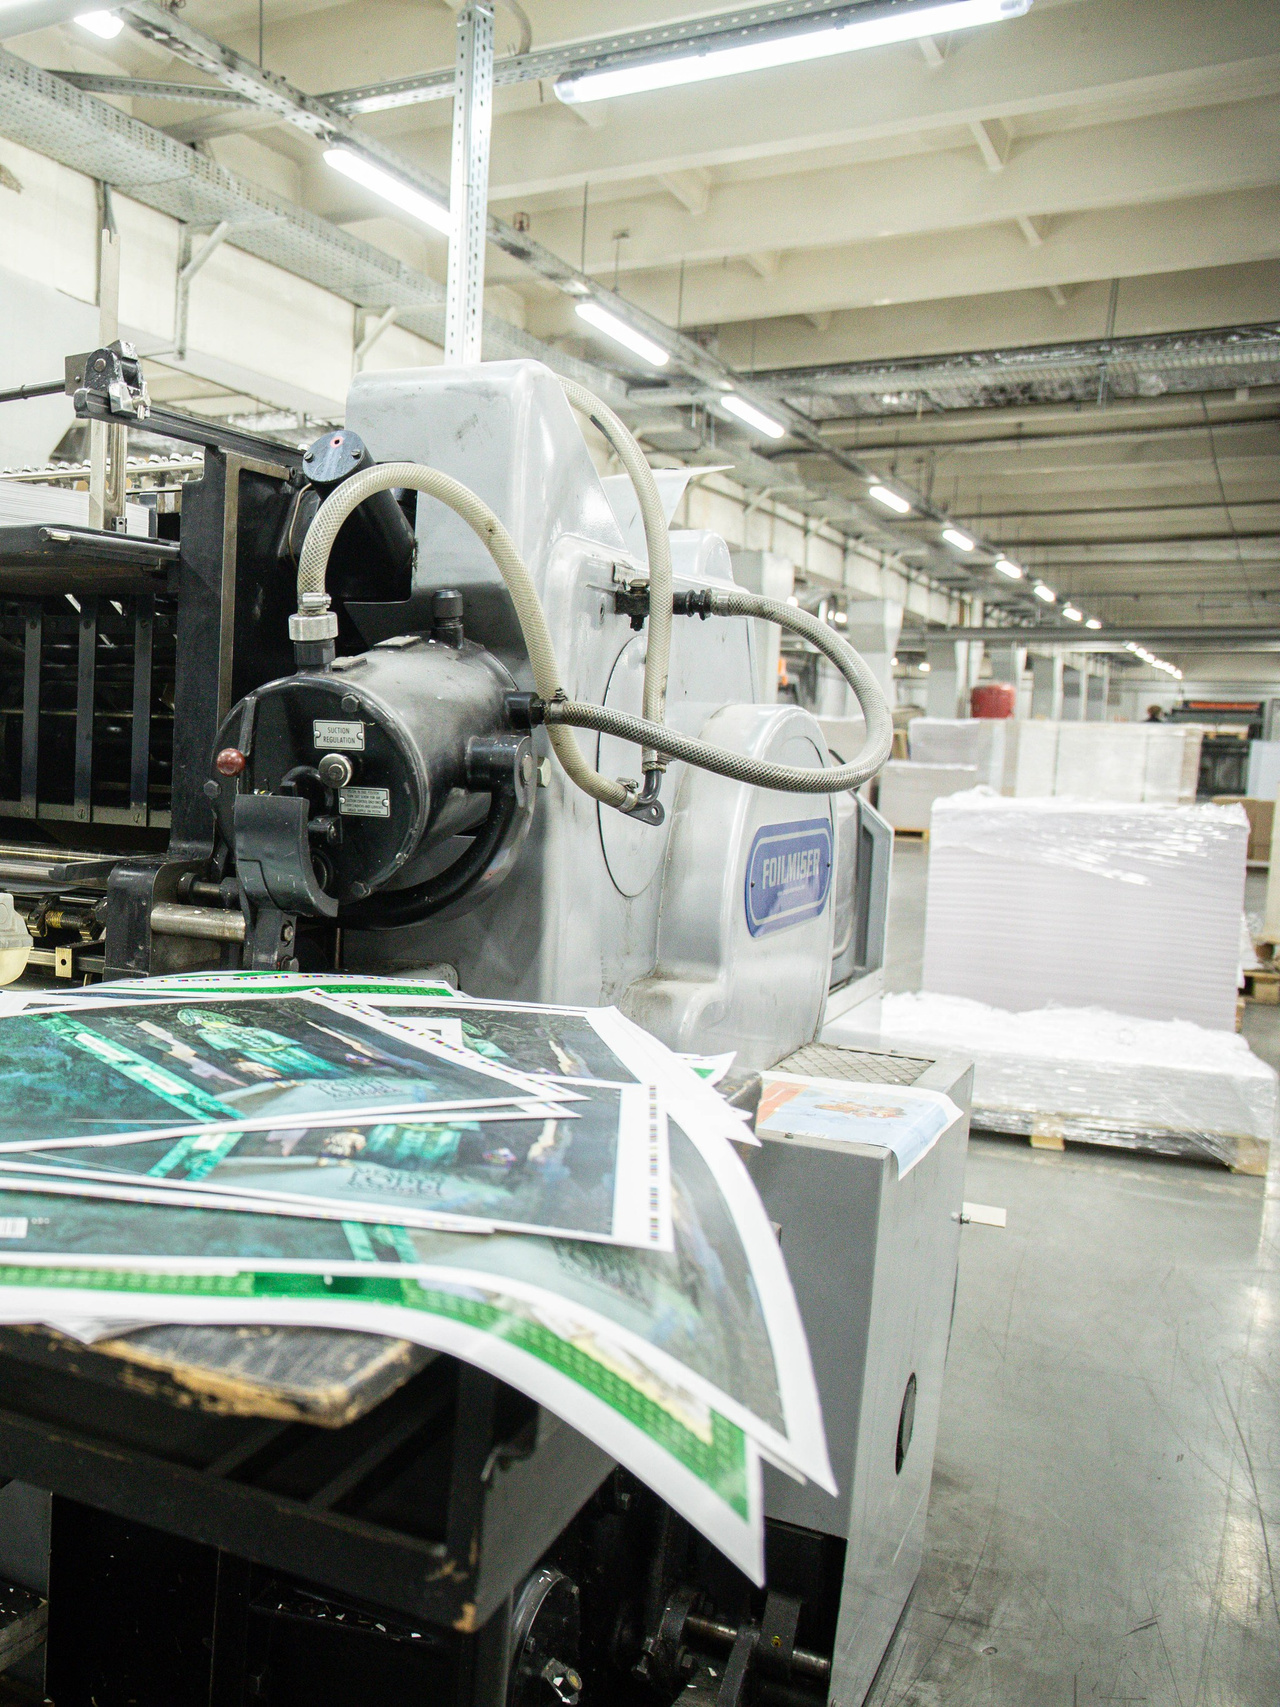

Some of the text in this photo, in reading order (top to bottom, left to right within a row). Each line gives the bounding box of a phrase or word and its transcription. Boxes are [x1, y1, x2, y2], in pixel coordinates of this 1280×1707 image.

[327, 726, 350, 735] SUCTION
[323, 735, 356, 744] REGULATION
[762, 848, 821, 890] FOILMISER
